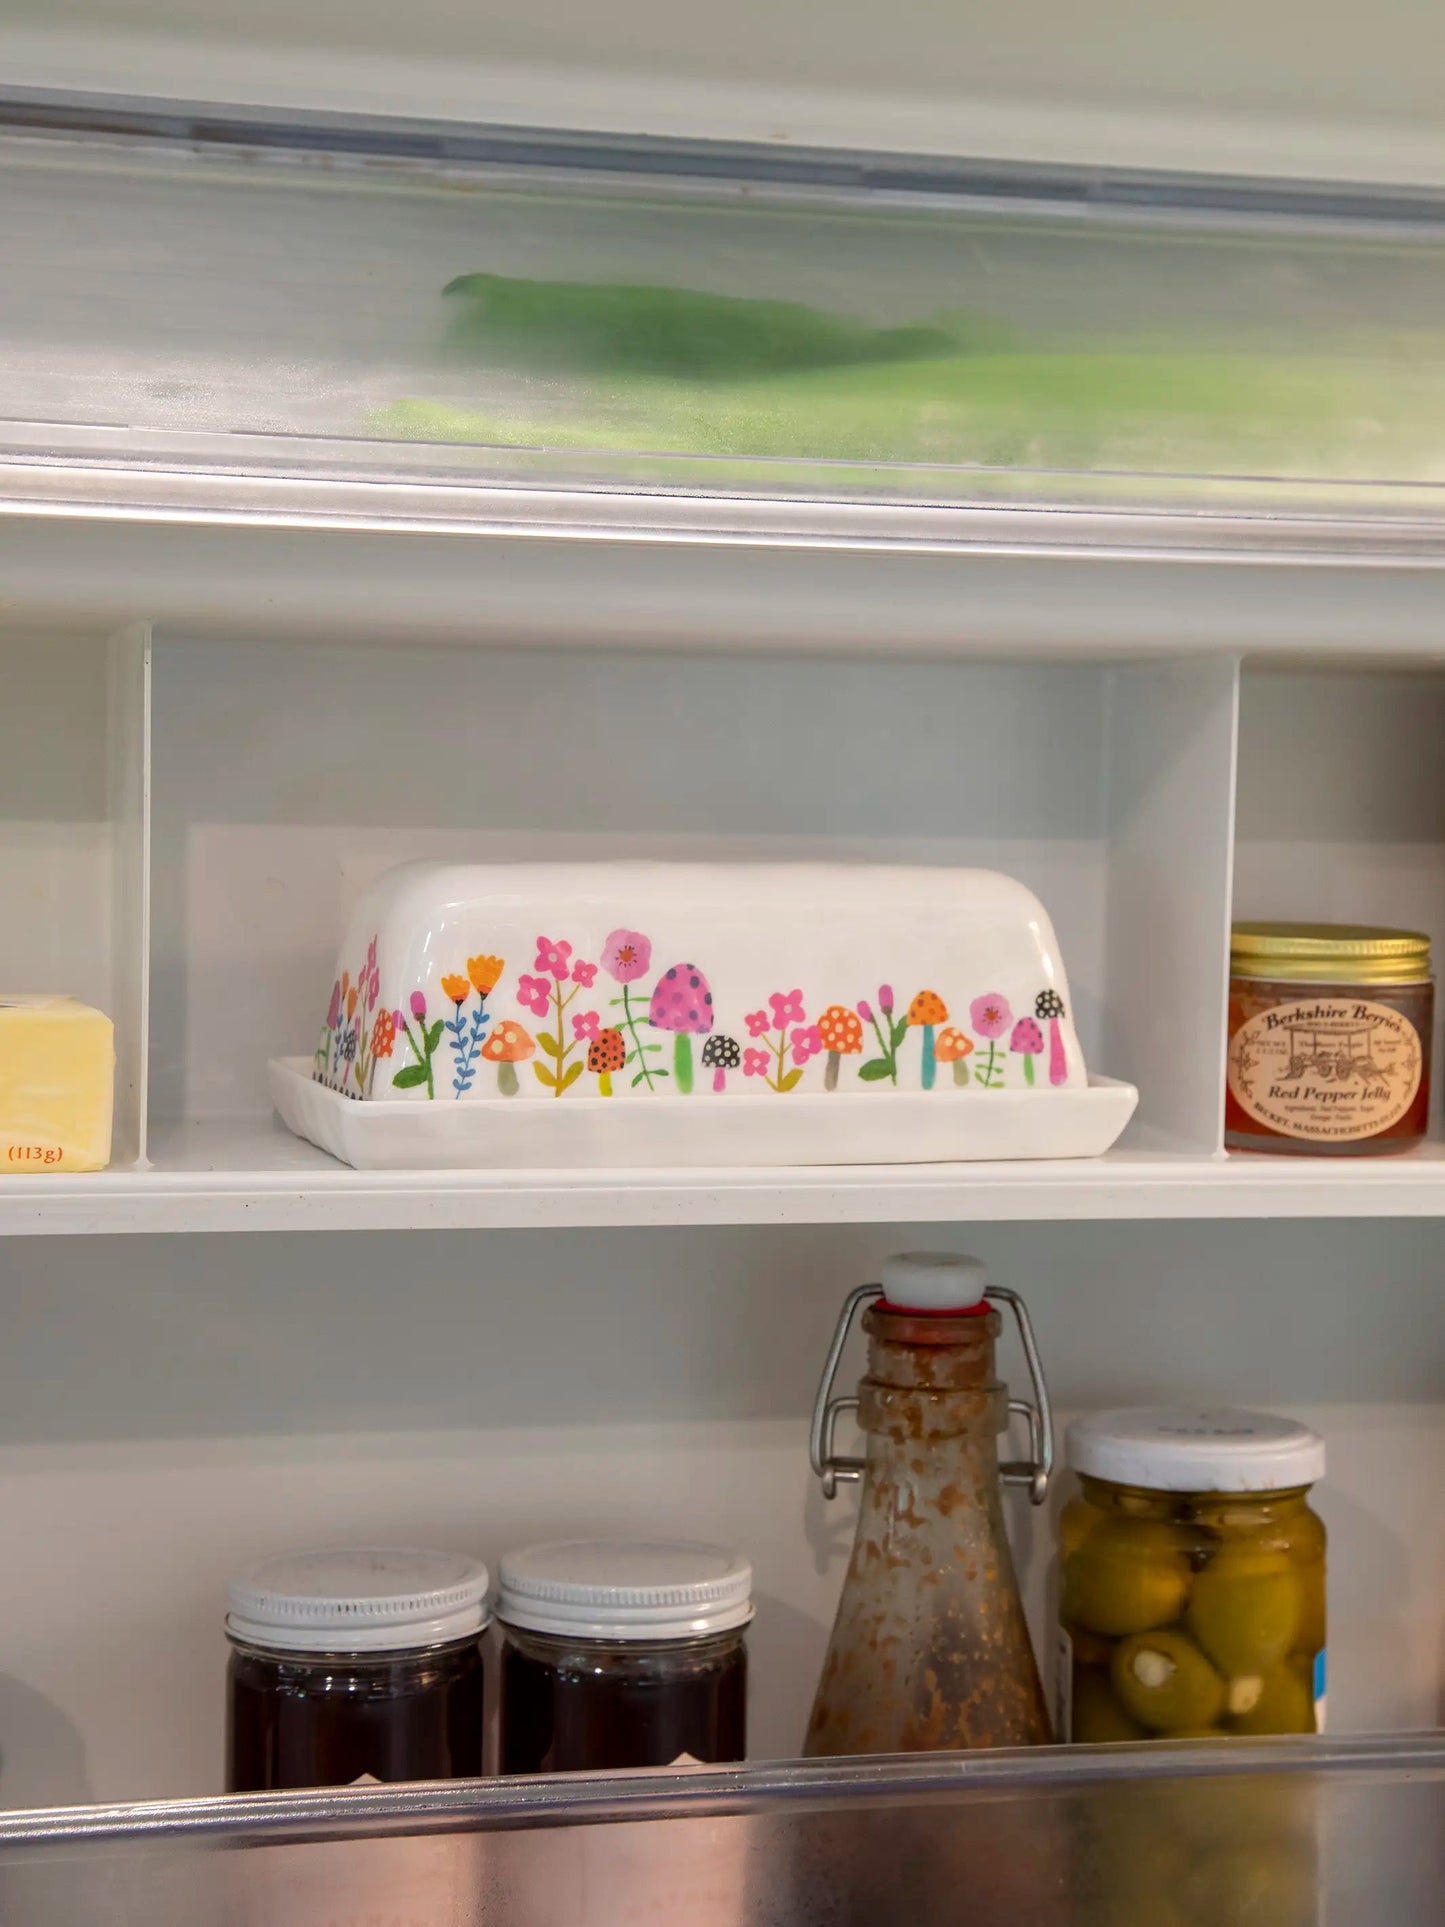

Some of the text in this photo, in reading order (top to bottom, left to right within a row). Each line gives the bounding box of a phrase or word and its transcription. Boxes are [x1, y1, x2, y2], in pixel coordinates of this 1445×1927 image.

[1261, 1004, 1347, 1030] Berkshire
[1268, 1086, 1391, 1103] Red Pepper Jelly
[8, 1146, 63, 1164] (113g)
